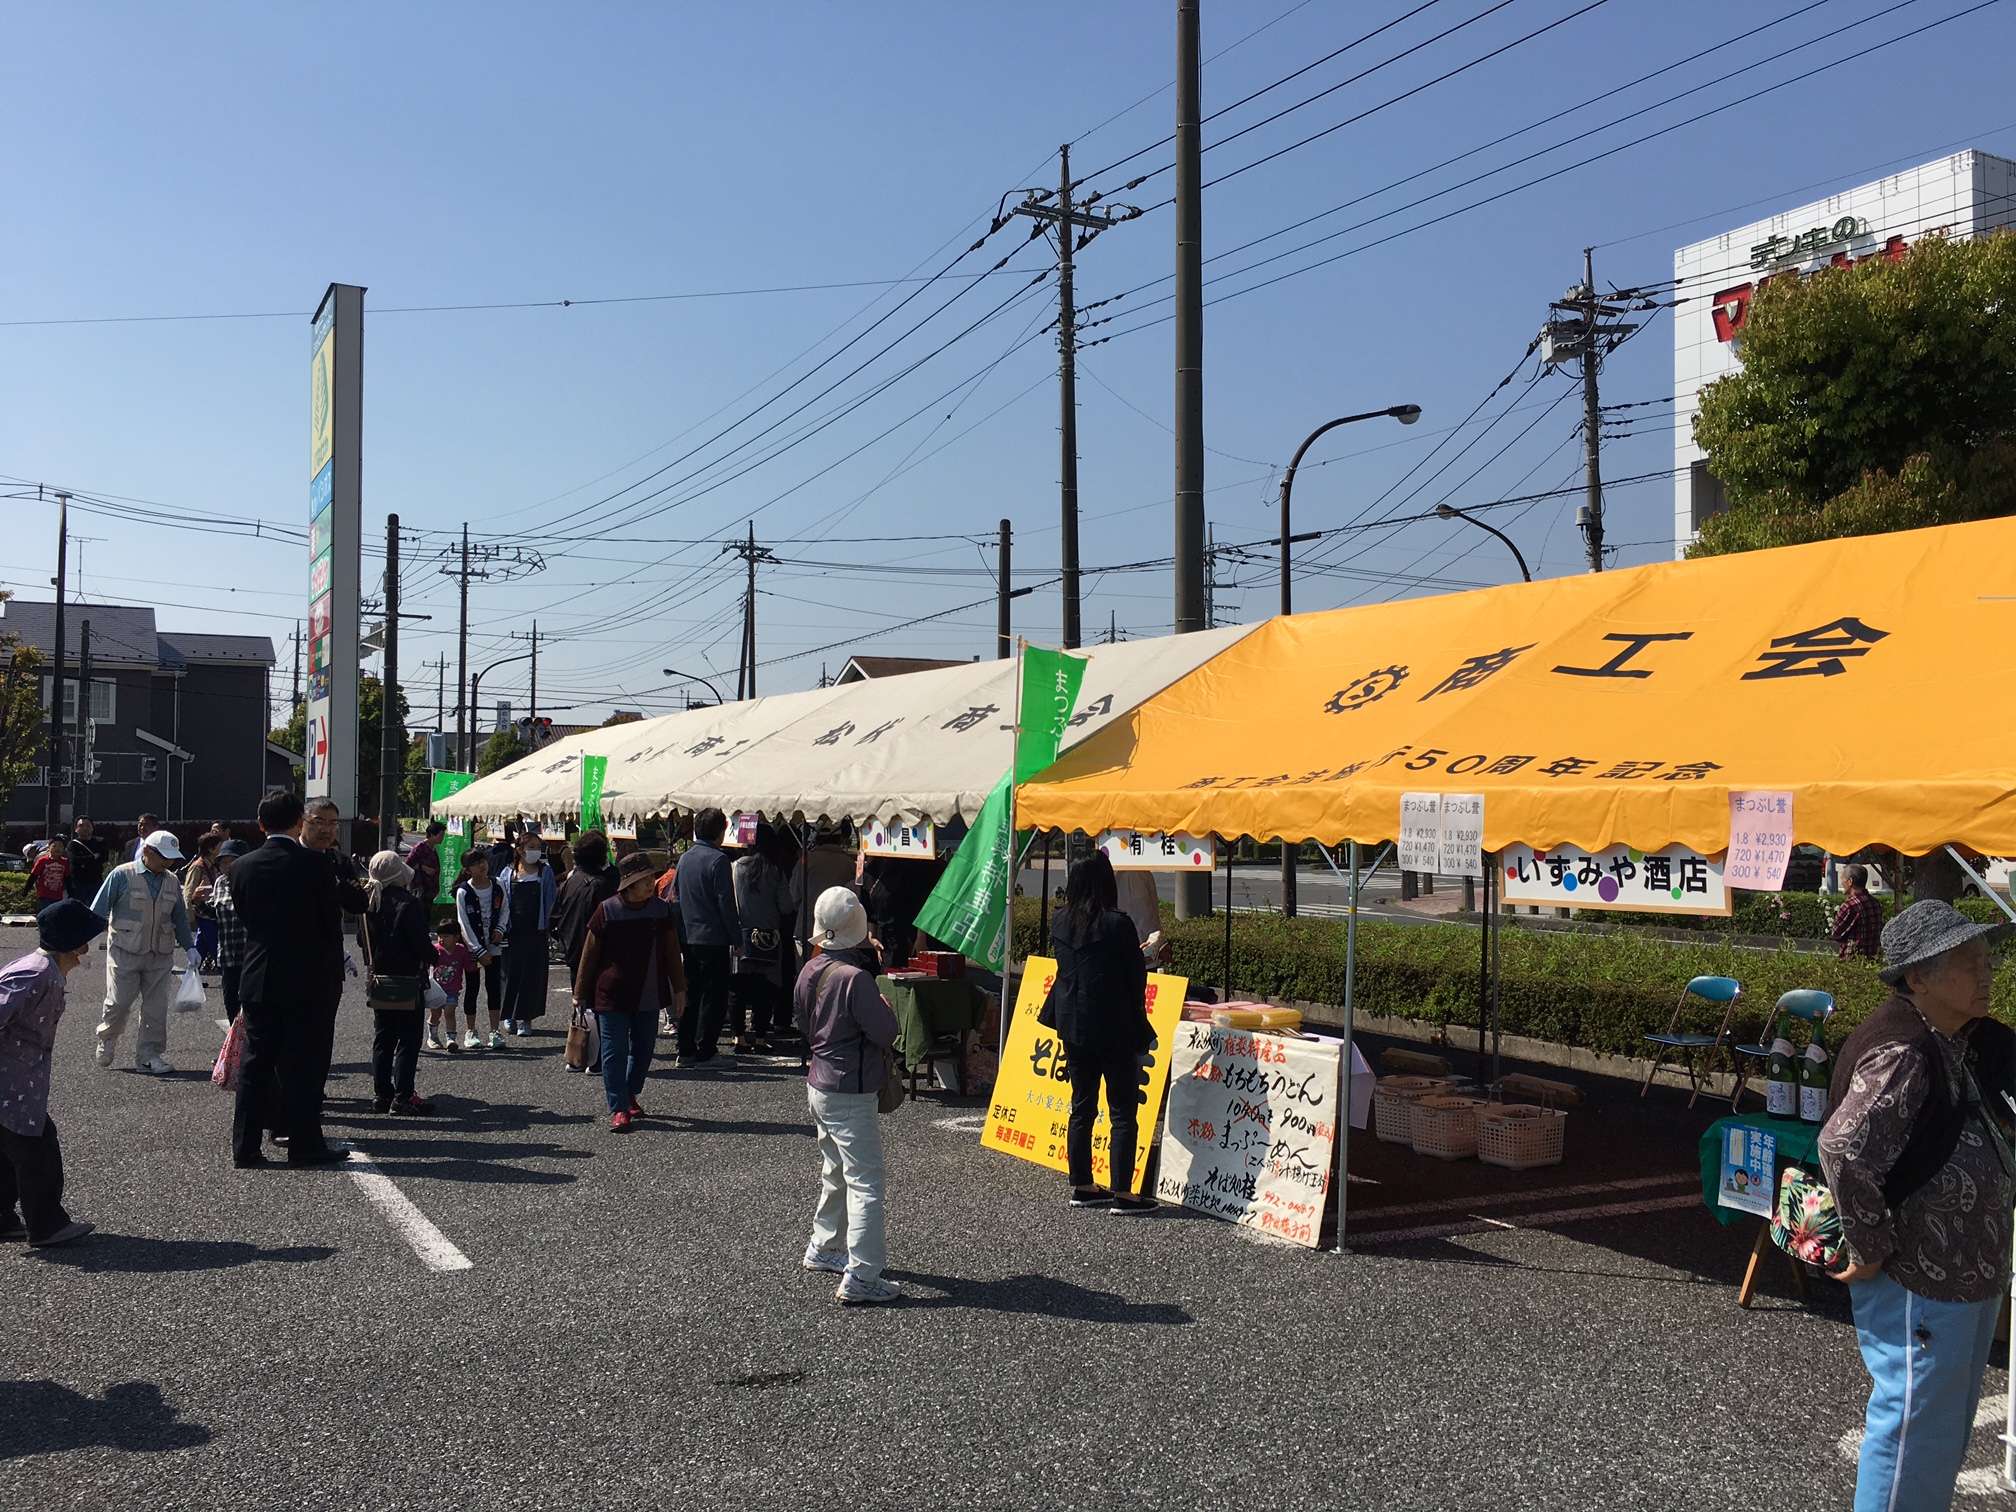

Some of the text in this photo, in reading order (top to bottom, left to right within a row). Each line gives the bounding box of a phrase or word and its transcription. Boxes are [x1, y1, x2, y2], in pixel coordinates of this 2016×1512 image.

[1750, 216, 1858, 270] デンキの
[1416, 617, 1891, 702] 商工会
[1735, 797, 1786, 813] まつぶし誉
[1416, 828, 1437, 839] ¥2,930
[1444, 830, 1478, 842] 1.8 ¥2,930
[1736, 832, 1786, 847] 1.8 ¥2,930
[1402, 841, 1436, 854] 720 ¥1,470
[1444, 844, 1477, 857] 720 ¥1,470
[1402, 855, 1413, 865] 300
[1423, 856, 1434, 867] 540
[1444, 858, 1455, 869] 300
[1465, 860, 1478, 870] 540
[1735, 849, 1785, 864] 720 ¥1,470
[1517, 855, 1708, 893] いずみや酒店
[1732, 865, 1751, 878] 300
[1767, 867, 1782, 880] 540
[1222, 1063, 1323, 1106] もちもちうどん
[992, 1104, 1017, 1123] 定休日
[1050, 1121, 1067, 1139] 松伏
[995, 1125, 1036, 1151] 毎週月曜日
[1749, 1130, 1762, 1173] 実施中
